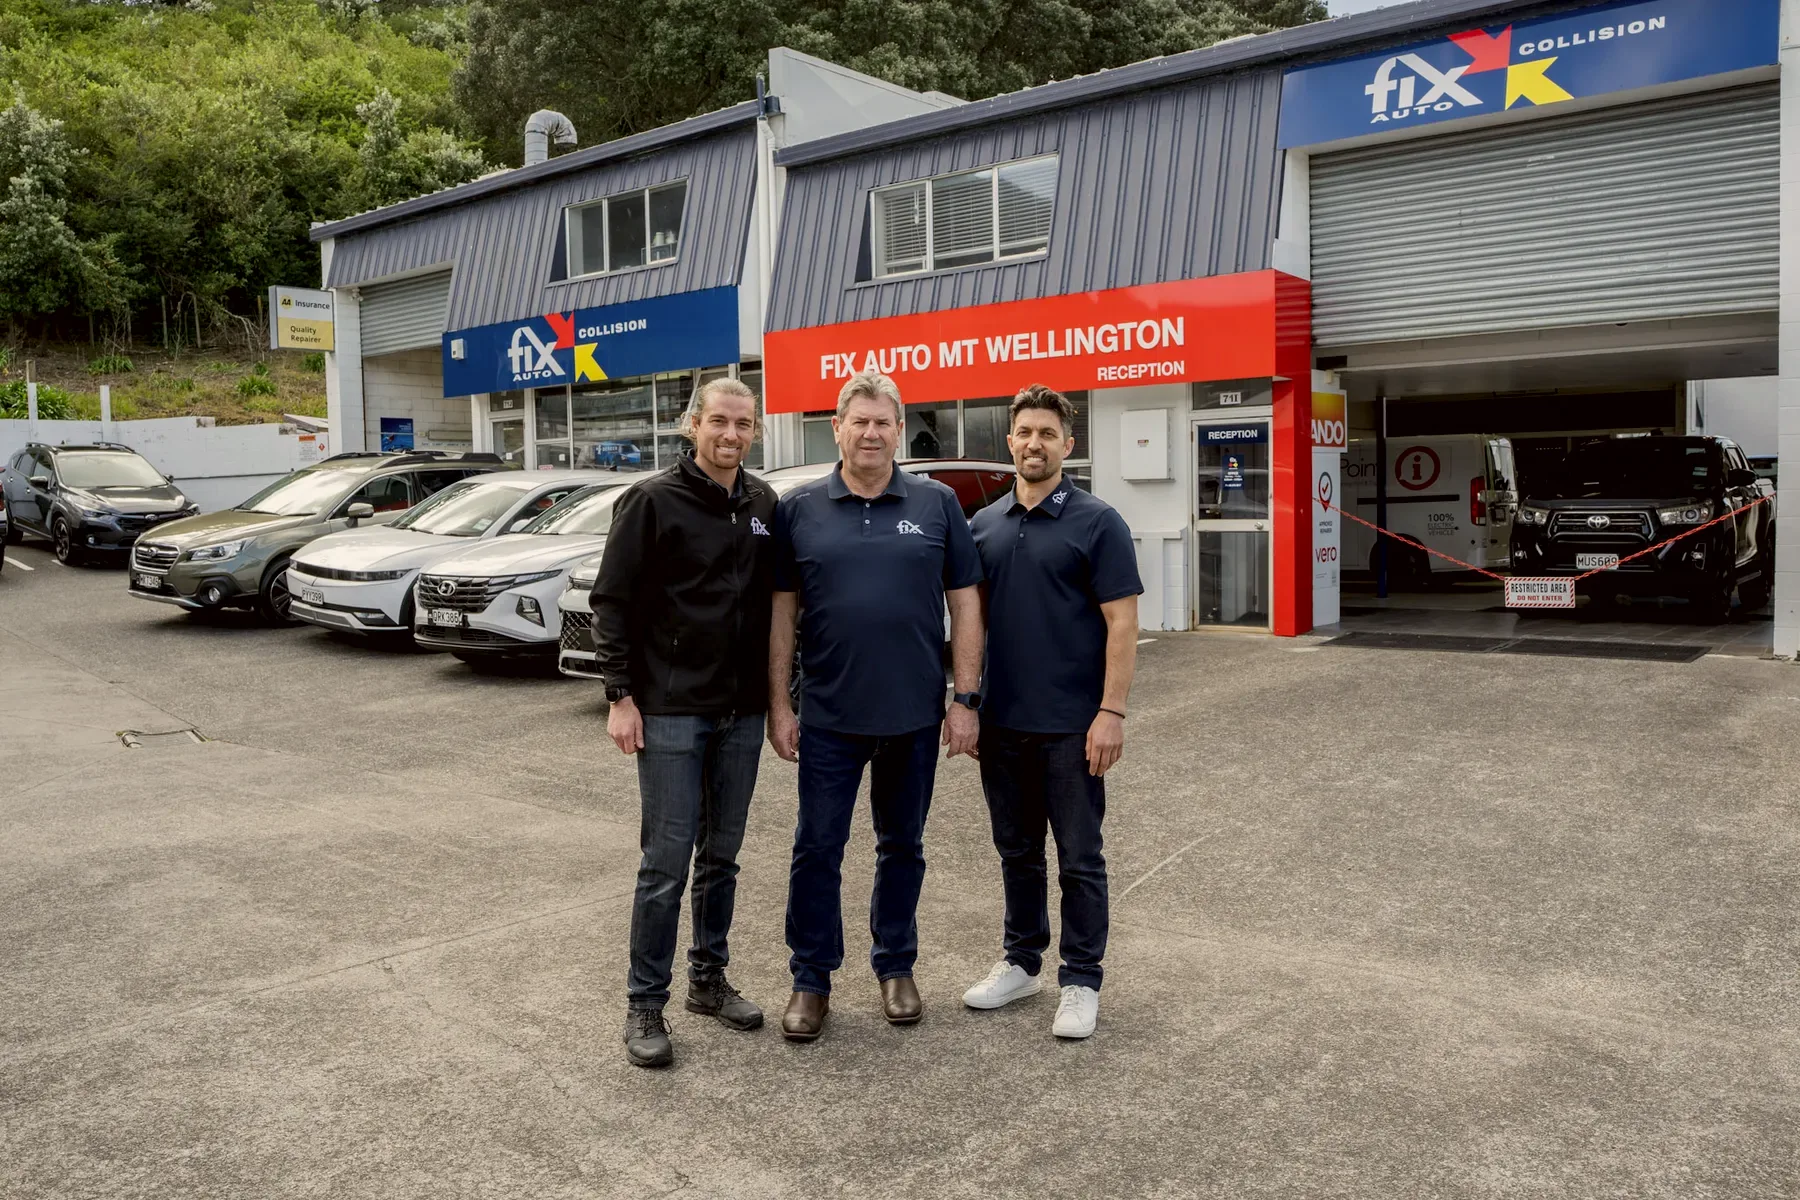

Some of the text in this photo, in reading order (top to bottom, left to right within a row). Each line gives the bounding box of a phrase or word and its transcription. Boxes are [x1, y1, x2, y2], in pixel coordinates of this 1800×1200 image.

[1518, 16, 1666, 56] COLLISION
[1370, 101, 1454, 124] AUTO
[295, 299, 330, 310] Insurance
[290, 325, 317, 336] Quality
[578, 318, 647, 339] COLLISION
[290, 334, 322, 344] Repairer
[820, 316, 1185, 380] FIX AUTO MT WELLINGTON
[512, 370, 552, 383] AUTO
[1097, 360, 1185, 382] RECEPTION
[1208, 429, 1259, 441] RECEPTION
[1427, 513, 1455, 522] 100%
[1315, 546, 1338, 563] vero
[1510, 583, 1568, 593] RESTRICTED AREA
